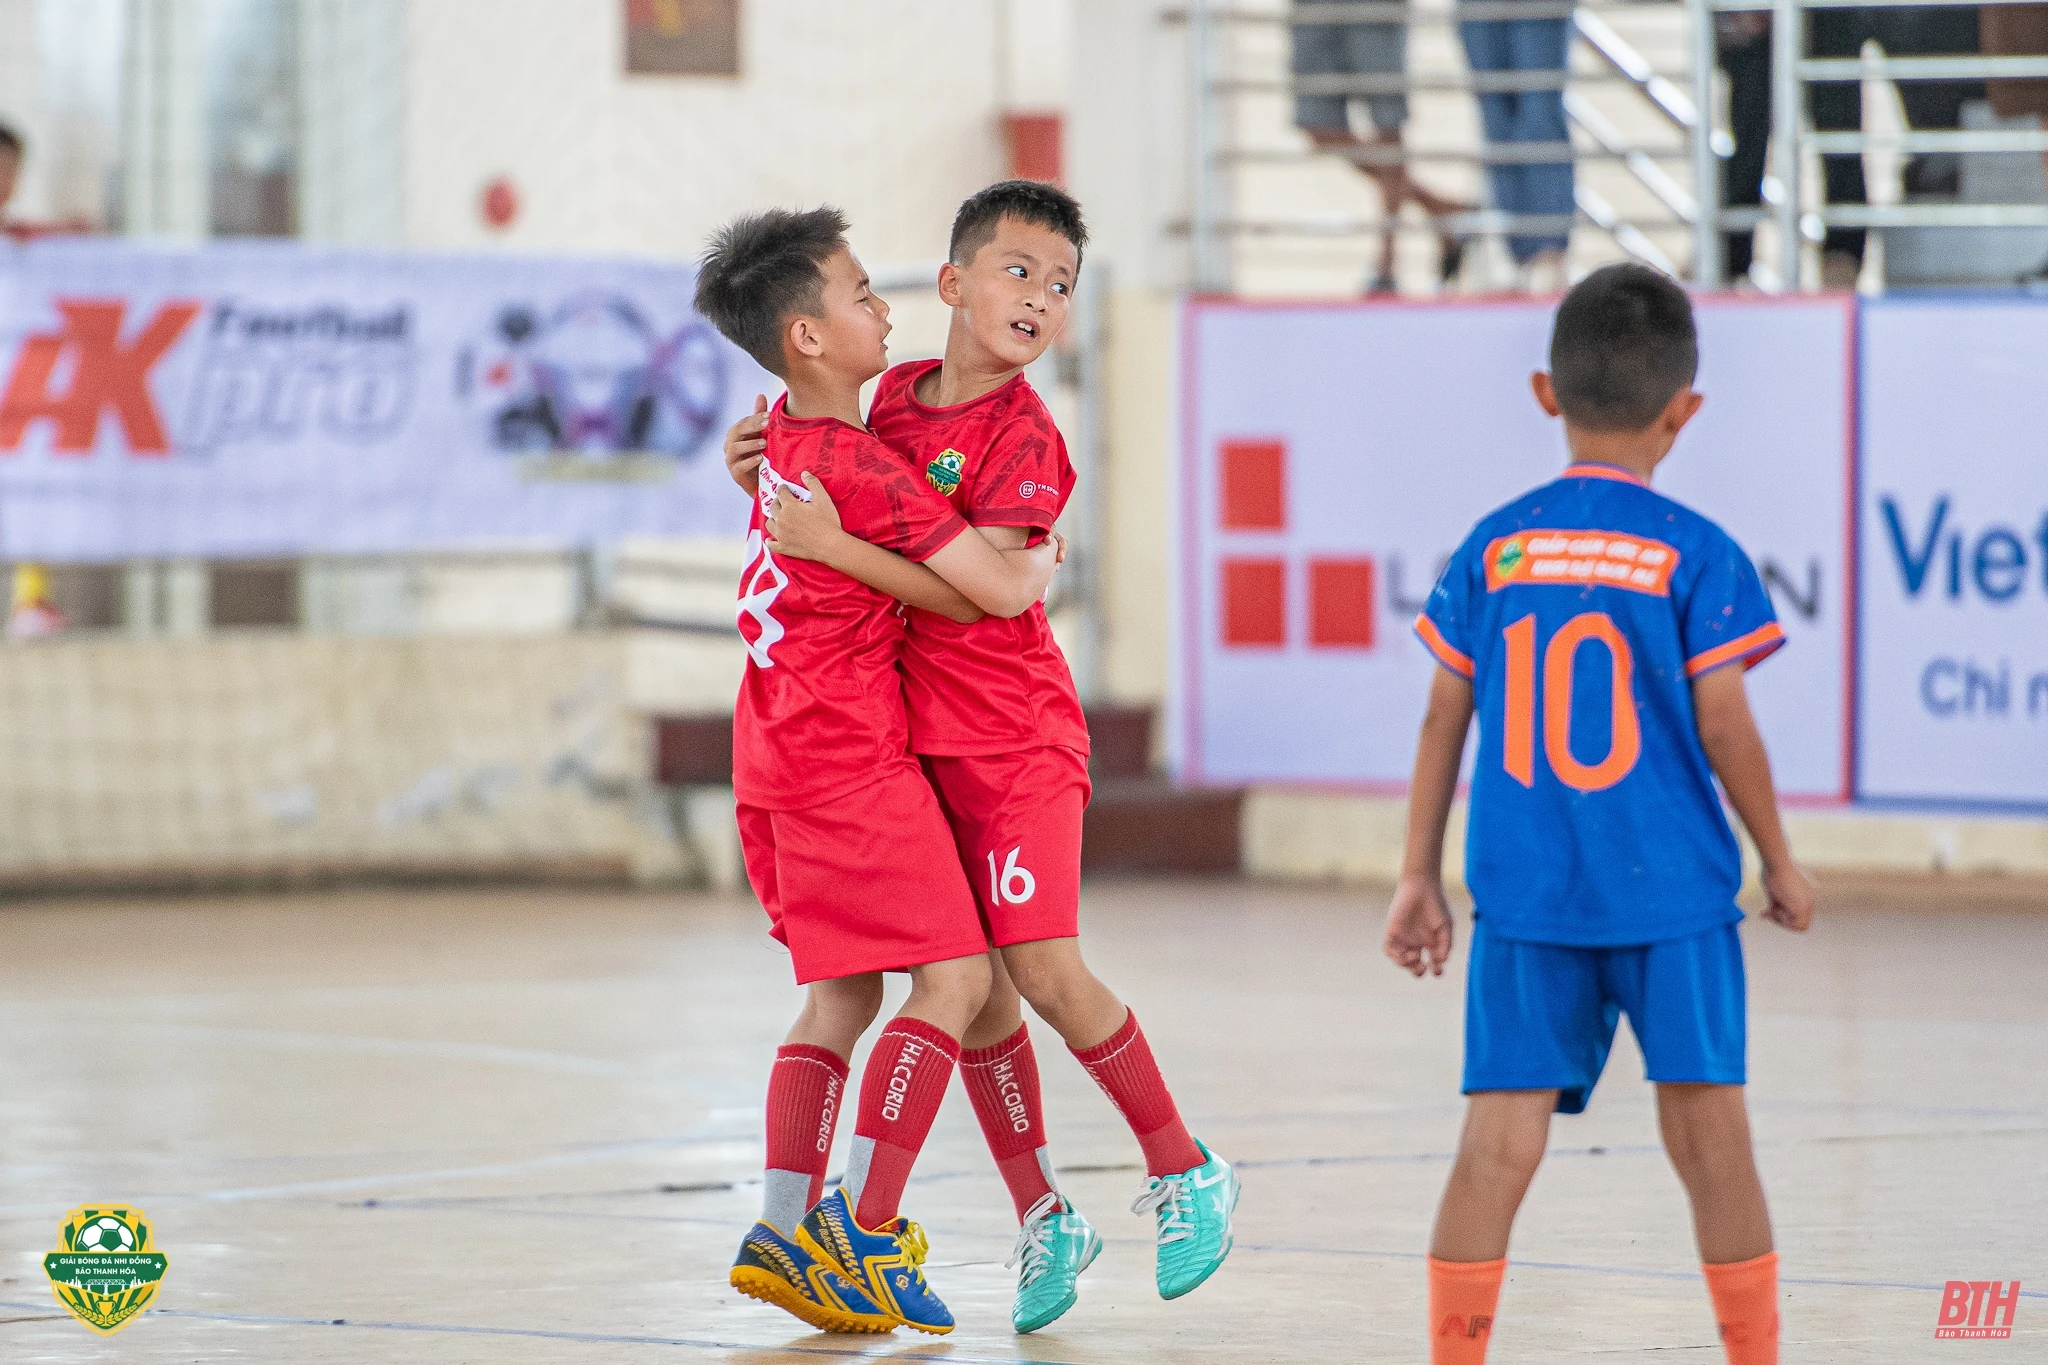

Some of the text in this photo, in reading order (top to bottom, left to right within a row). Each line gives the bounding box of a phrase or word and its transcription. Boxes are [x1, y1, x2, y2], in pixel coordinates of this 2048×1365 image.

[1878, 490, 2048, 603] Vie
[1502, 612, 1642, 791] 10
[1918, 658, 2012, 718] Chi
[986, 845, 1036, 907] 16
[816, 1075, 842, 1152] HACORIO
[881, 1041, 923, 1121] HACORIO
[993, 1058, 1030, 1133] HACORIO
